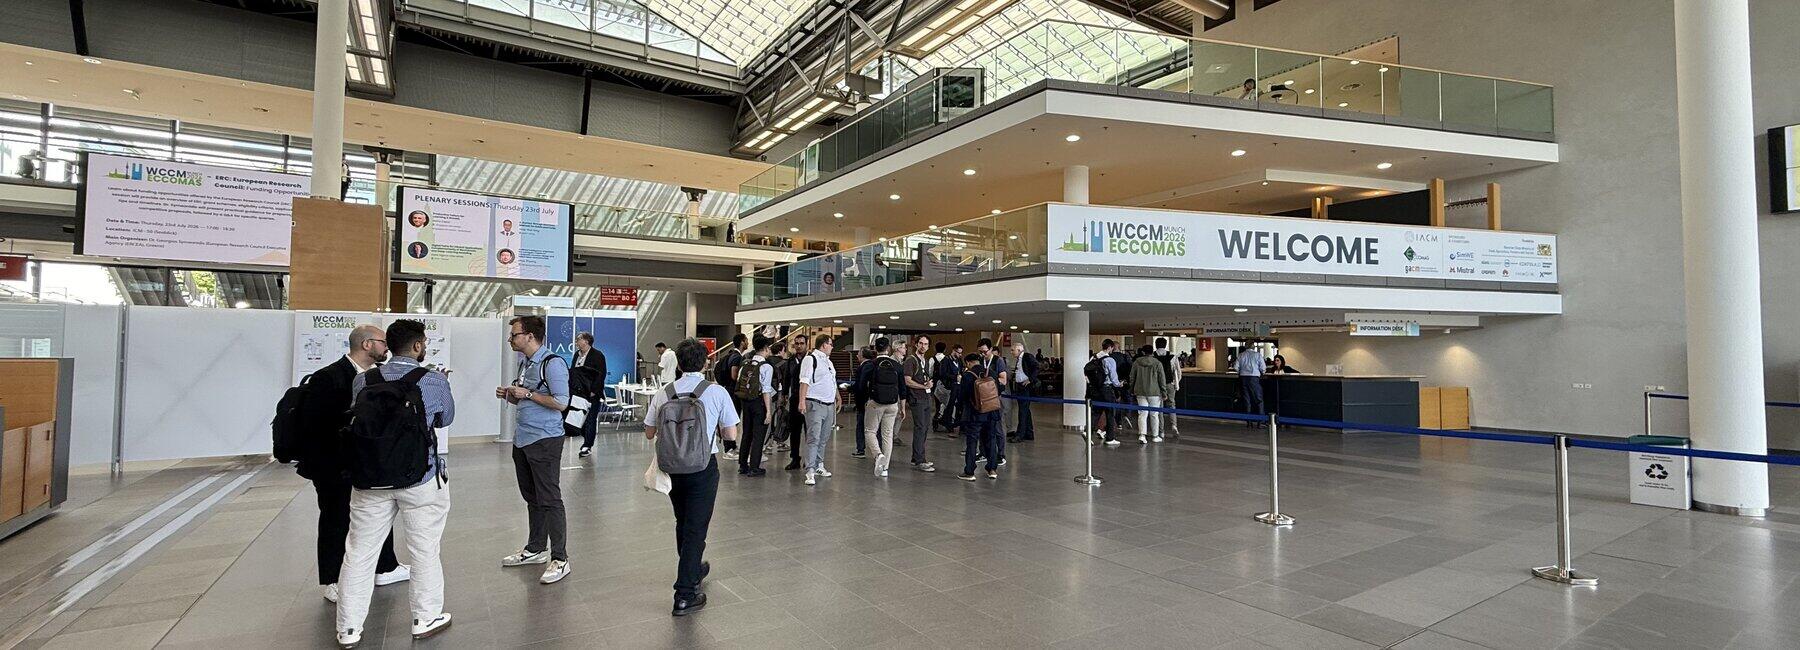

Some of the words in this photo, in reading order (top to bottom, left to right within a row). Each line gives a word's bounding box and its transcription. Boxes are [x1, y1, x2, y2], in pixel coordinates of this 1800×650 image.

[146, 166, 186, 178] WCCM
[147, 174, 202, 186] ECCOMAS
[415, 195, 451, 204] PLENARY
[453, 199, 493, 208] SESSIONS:
[493, 203, 524, 212] Thursday
[1107, 222, 1163, 240] WCCM
[1164, 233, 1185, 242] 2026
[1416, 234, 1438, 242] IACM
[1109, 239, 1185, 256] ECCOMAS
[1218, 229, 1378, 265] WELCOME
